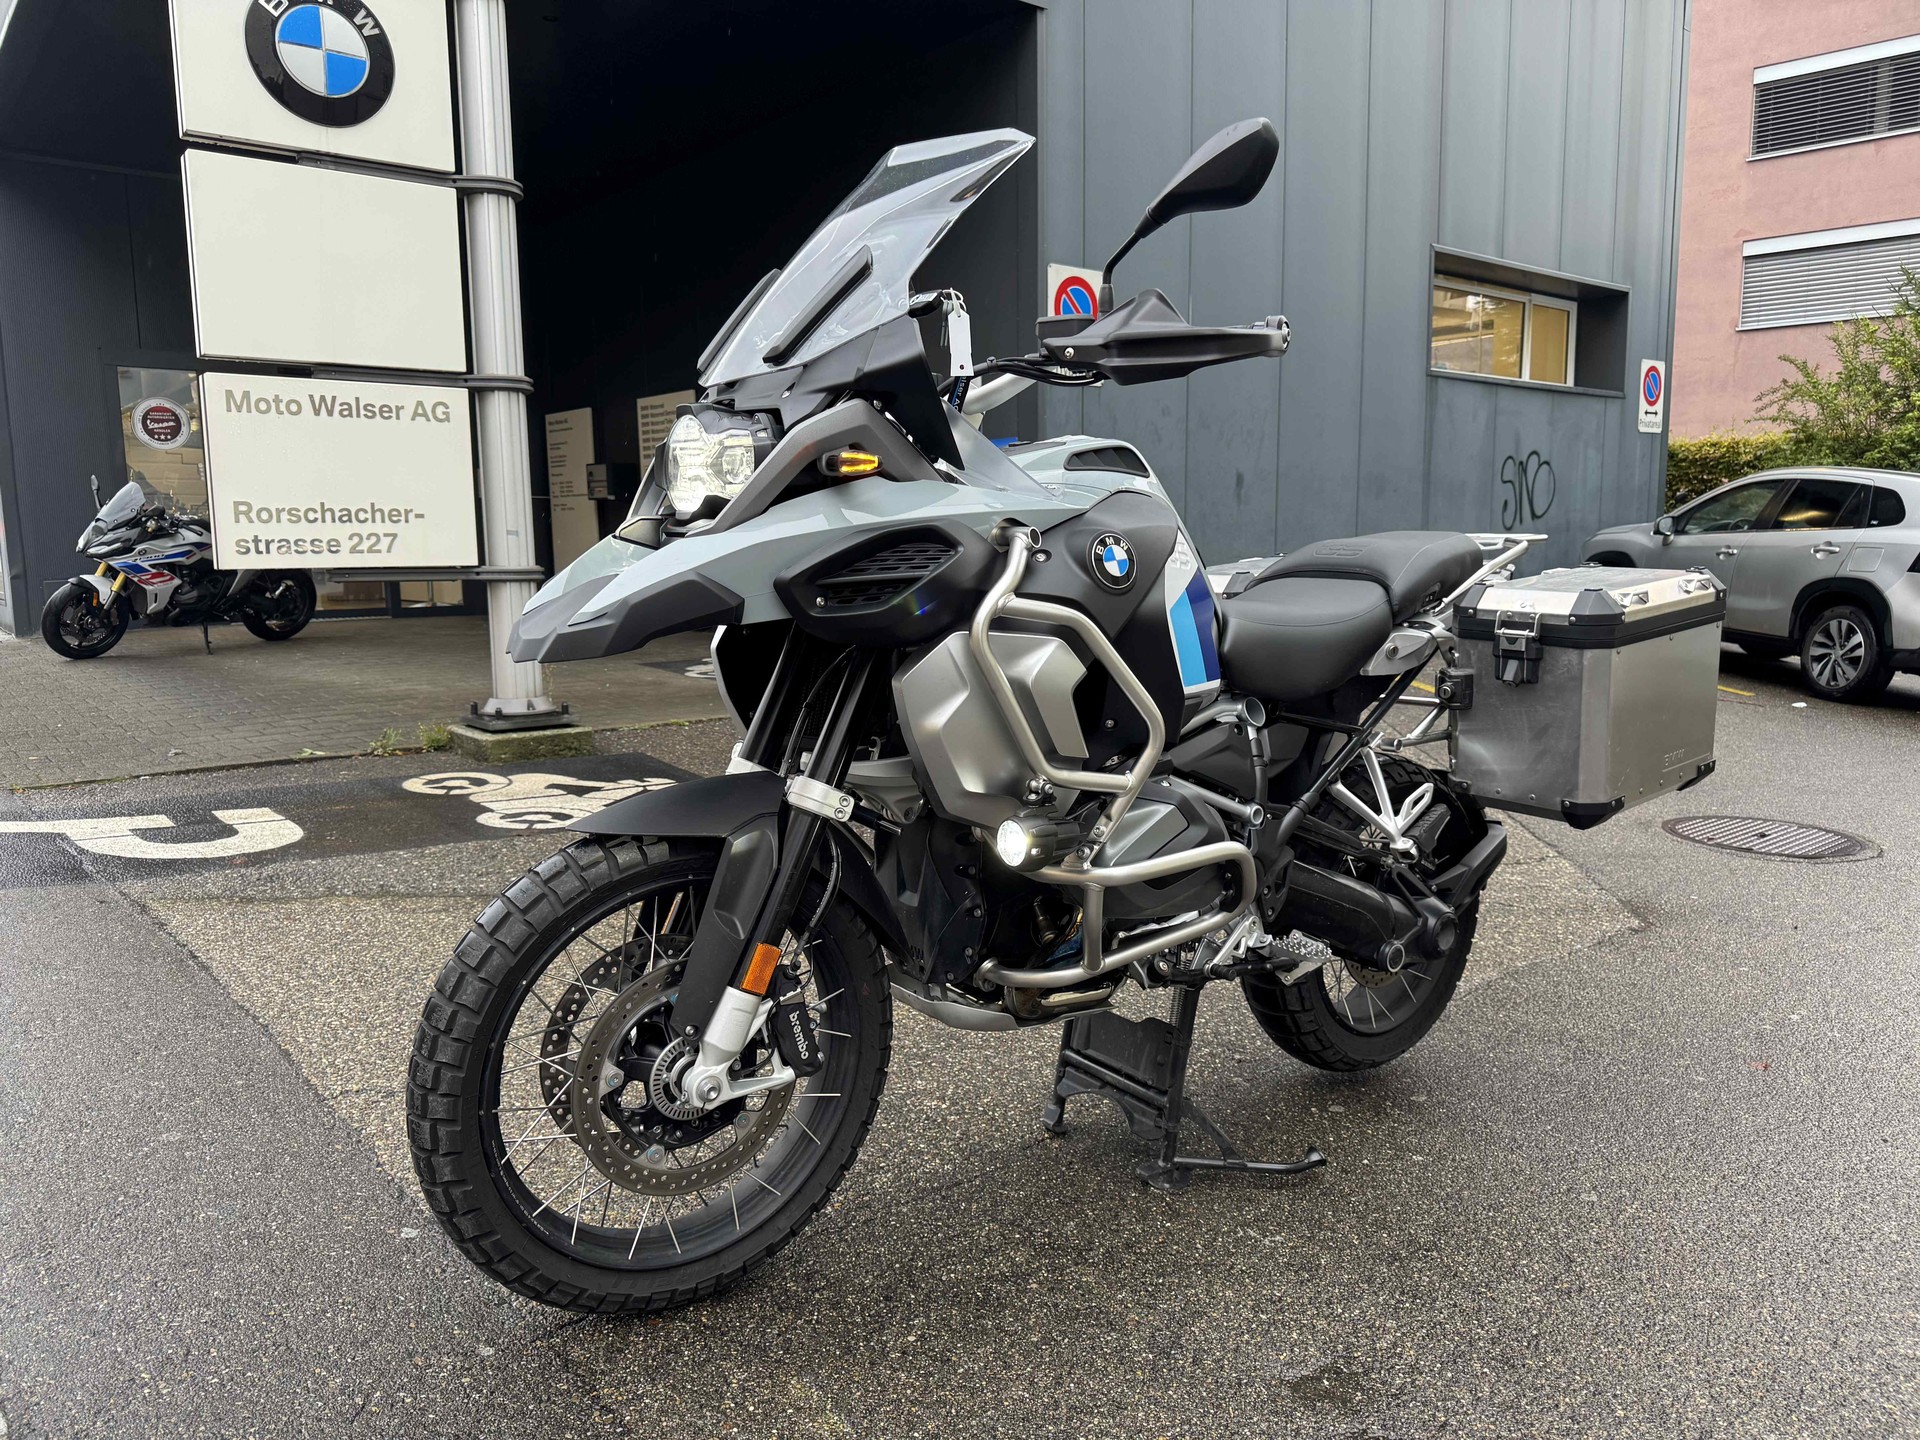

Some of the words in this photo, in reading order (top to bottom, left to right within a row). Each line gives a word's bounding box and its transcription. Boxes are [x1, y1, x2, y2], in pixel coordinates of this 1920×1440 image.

[258, 0, 380, 37] BW
[224, 389, 302, 416] Moto
[308, 394, 405, 421] Walser
[410, 400, 451, 423] AG
[146, 419, 176, 429] Vespa
[233, 501, 425, 524] Rorschacher-
[235, 535, 342, 555] strasse
[348, 533, 398, 554] 227
[1096, 536, 1129, 556] BMW
[789, 1010, 809, 1060] brembo
